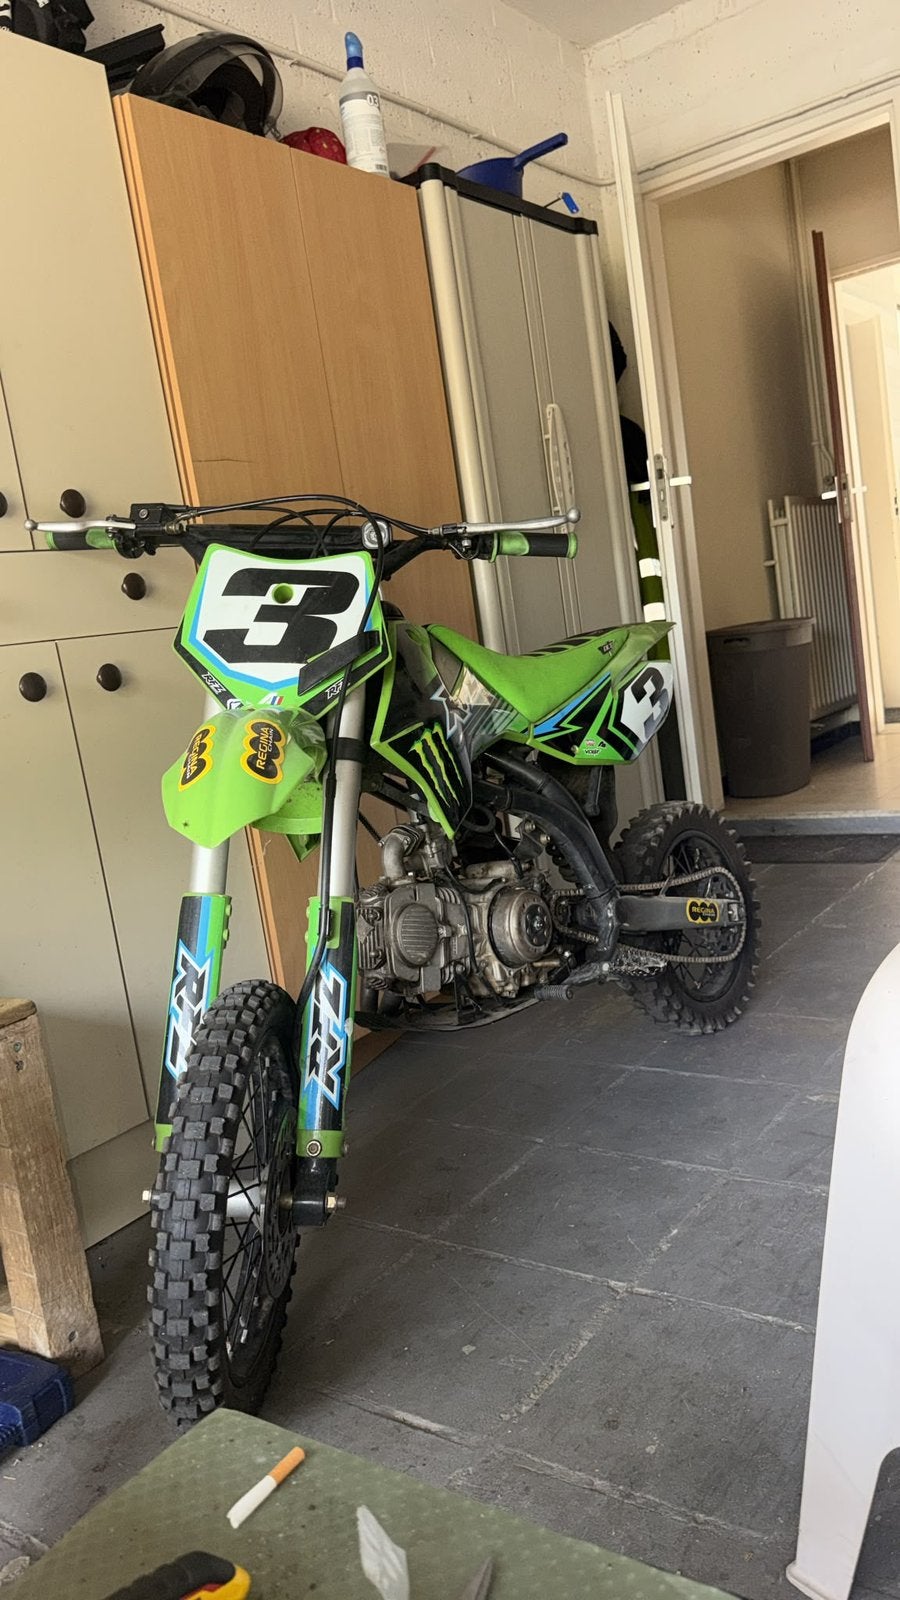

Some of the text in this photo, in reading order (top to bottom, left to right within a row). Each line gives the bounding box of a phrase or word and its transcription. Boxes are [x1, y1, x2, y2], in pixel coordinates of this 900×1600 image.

[367, 94, 379, 106] 03
[203, 568, 360, 664] 3
[201, 672, 227, 695] RFZ
[325, 678, 350, 700] RF
[630, 666, 669, 738] 3
[189, 733, 203, 776] REGINA
[255, 727, 270, 770] REGINA
[267, 727, 275, 752] CHAIN
